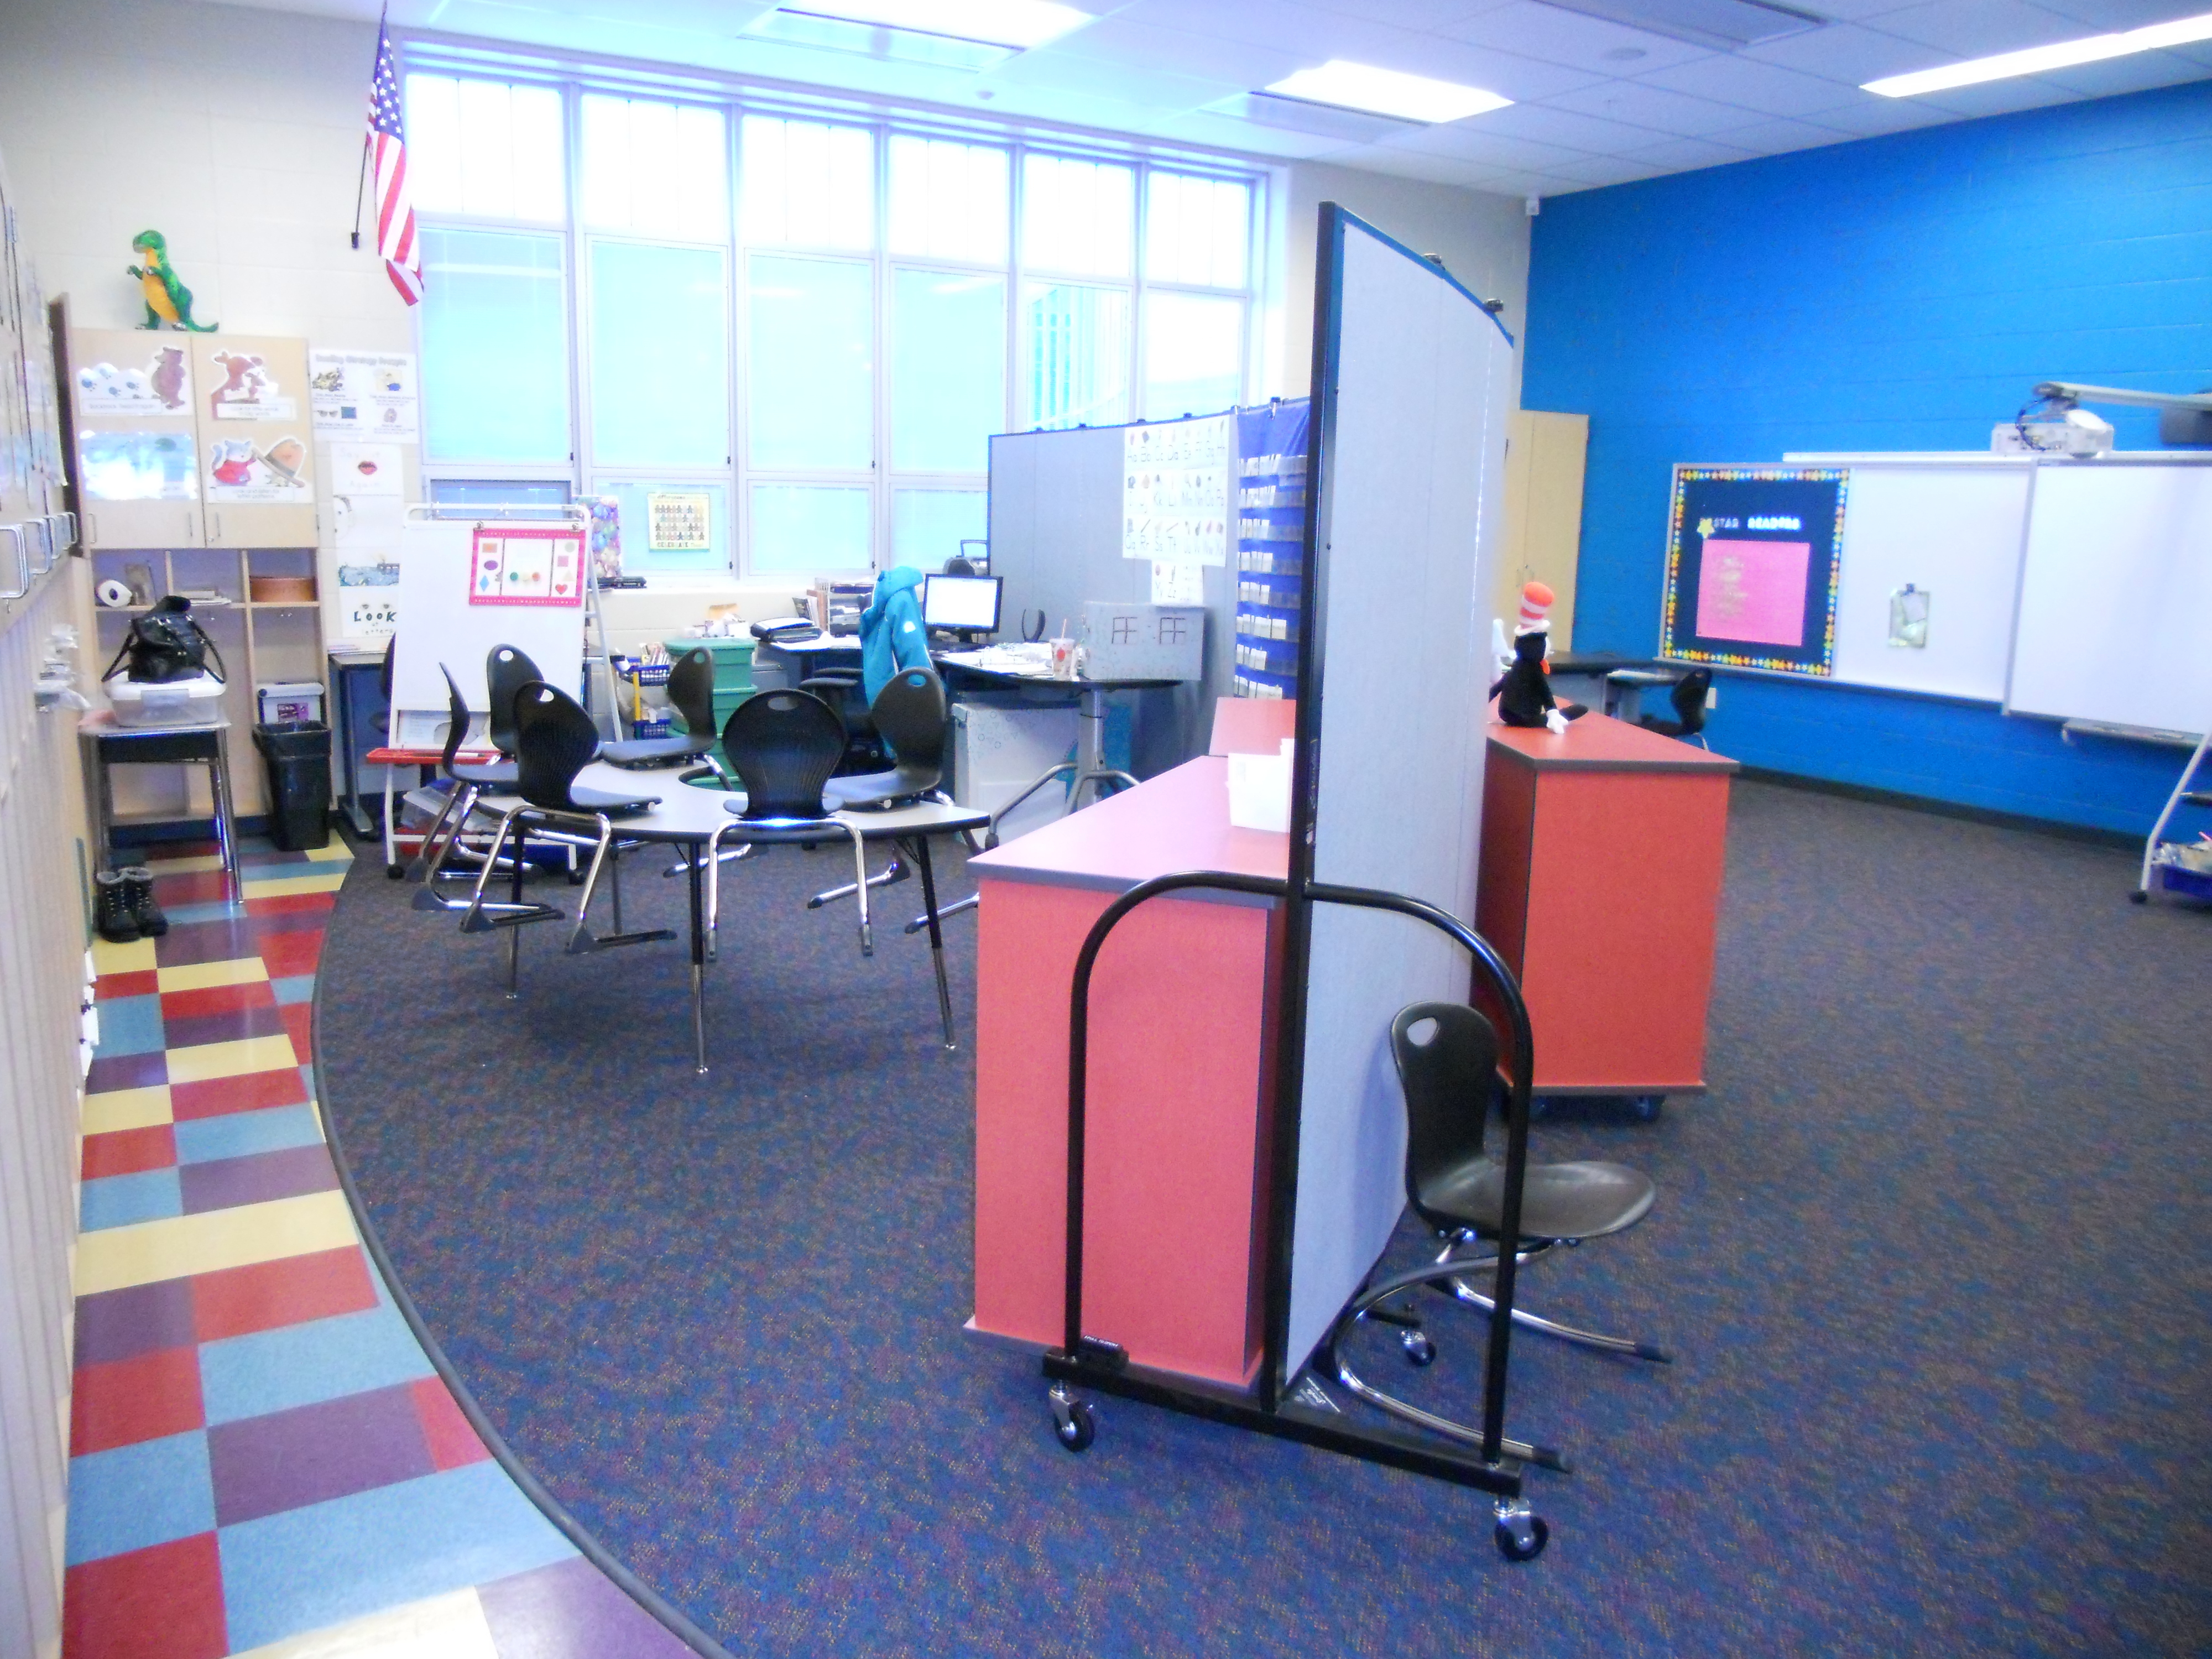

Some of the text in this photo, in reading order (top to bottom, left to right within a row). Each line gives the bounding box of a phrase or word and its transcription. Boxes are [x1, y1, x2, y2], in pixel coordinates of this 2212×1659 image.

[1126, 448, 1137, 462] Aa
[1141, 446, 1151, 462] Bb
[1155, 445, 1164, 461] Cc
[1184, 442, 1191, 460] Ee
[1206, 440, 1214, 465] Gg
[1154, 491, 1164, 507] Kk
[1182, 490, 1193, 507] Mm
[1195, 490, 1203, 507] Nn
[1206, 489, 1214, 507] Oo
[1217, 489, 1224, 511] Pp
[1747, 517, 1801, 530] READERS
[1140, 535, 1150, 550] Rr
[1155, 535, 1164, 552] Ss
[1167, 536, 1176, 552] Tt
[1155, 581, 1164, 599] Yy
[1168, 581, 1176, 598] Zz
